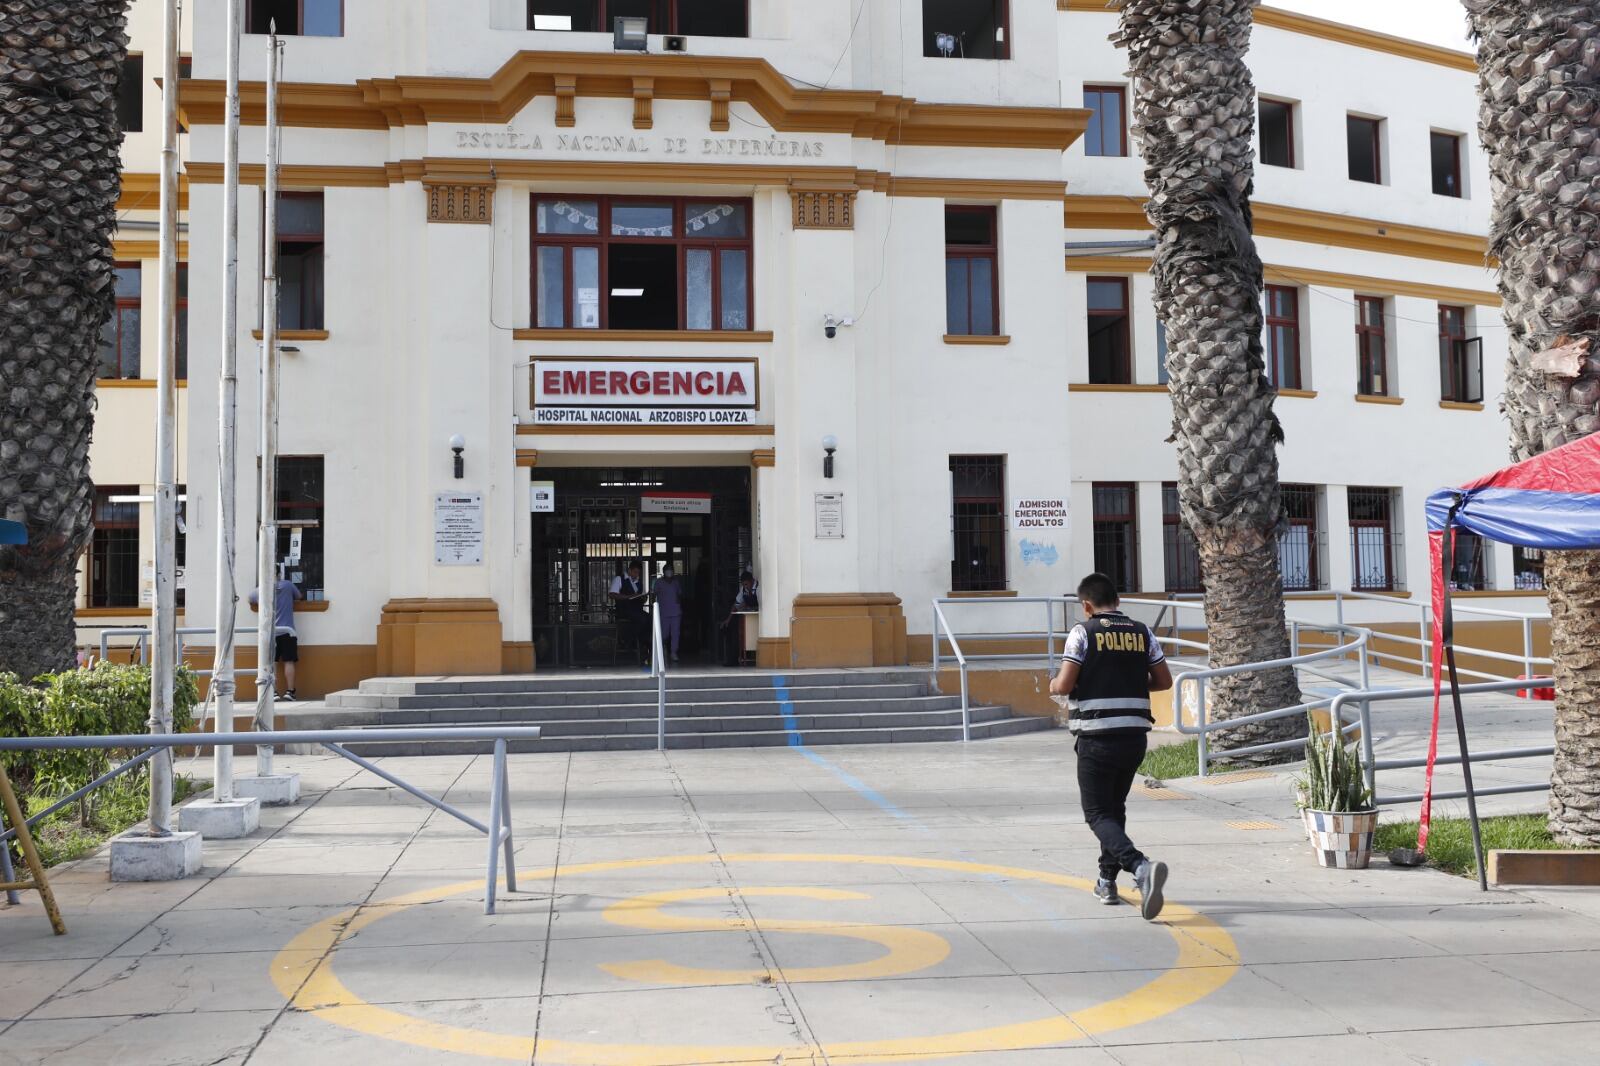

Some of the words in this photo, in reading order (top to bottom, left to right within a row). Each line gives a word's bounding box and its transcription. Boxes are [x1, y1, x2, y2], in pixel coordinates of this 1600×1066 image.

[456, 131, 543, 150] ESCUELA
[556, 134, 649, 152] NACIONAL
[664, 137, 687, 154] DE
[702, 138, 824, 157] ENFERMERAS
[543, 370, 747, 396] EMERGENCIA
[537, 410, 588, 423] HOSPITAL
[590, 410, 643, 423] NACIONAL
[649, 410, 707, 423] ARZOBISPO
[709, 410, 748, 423] LOAYZA
[1019, 500, 1063, 508] ADMISION
[1015, 509, 1067, 518] EMERGENCIA
[1019, 519, 1064, 527] ADULTOS
